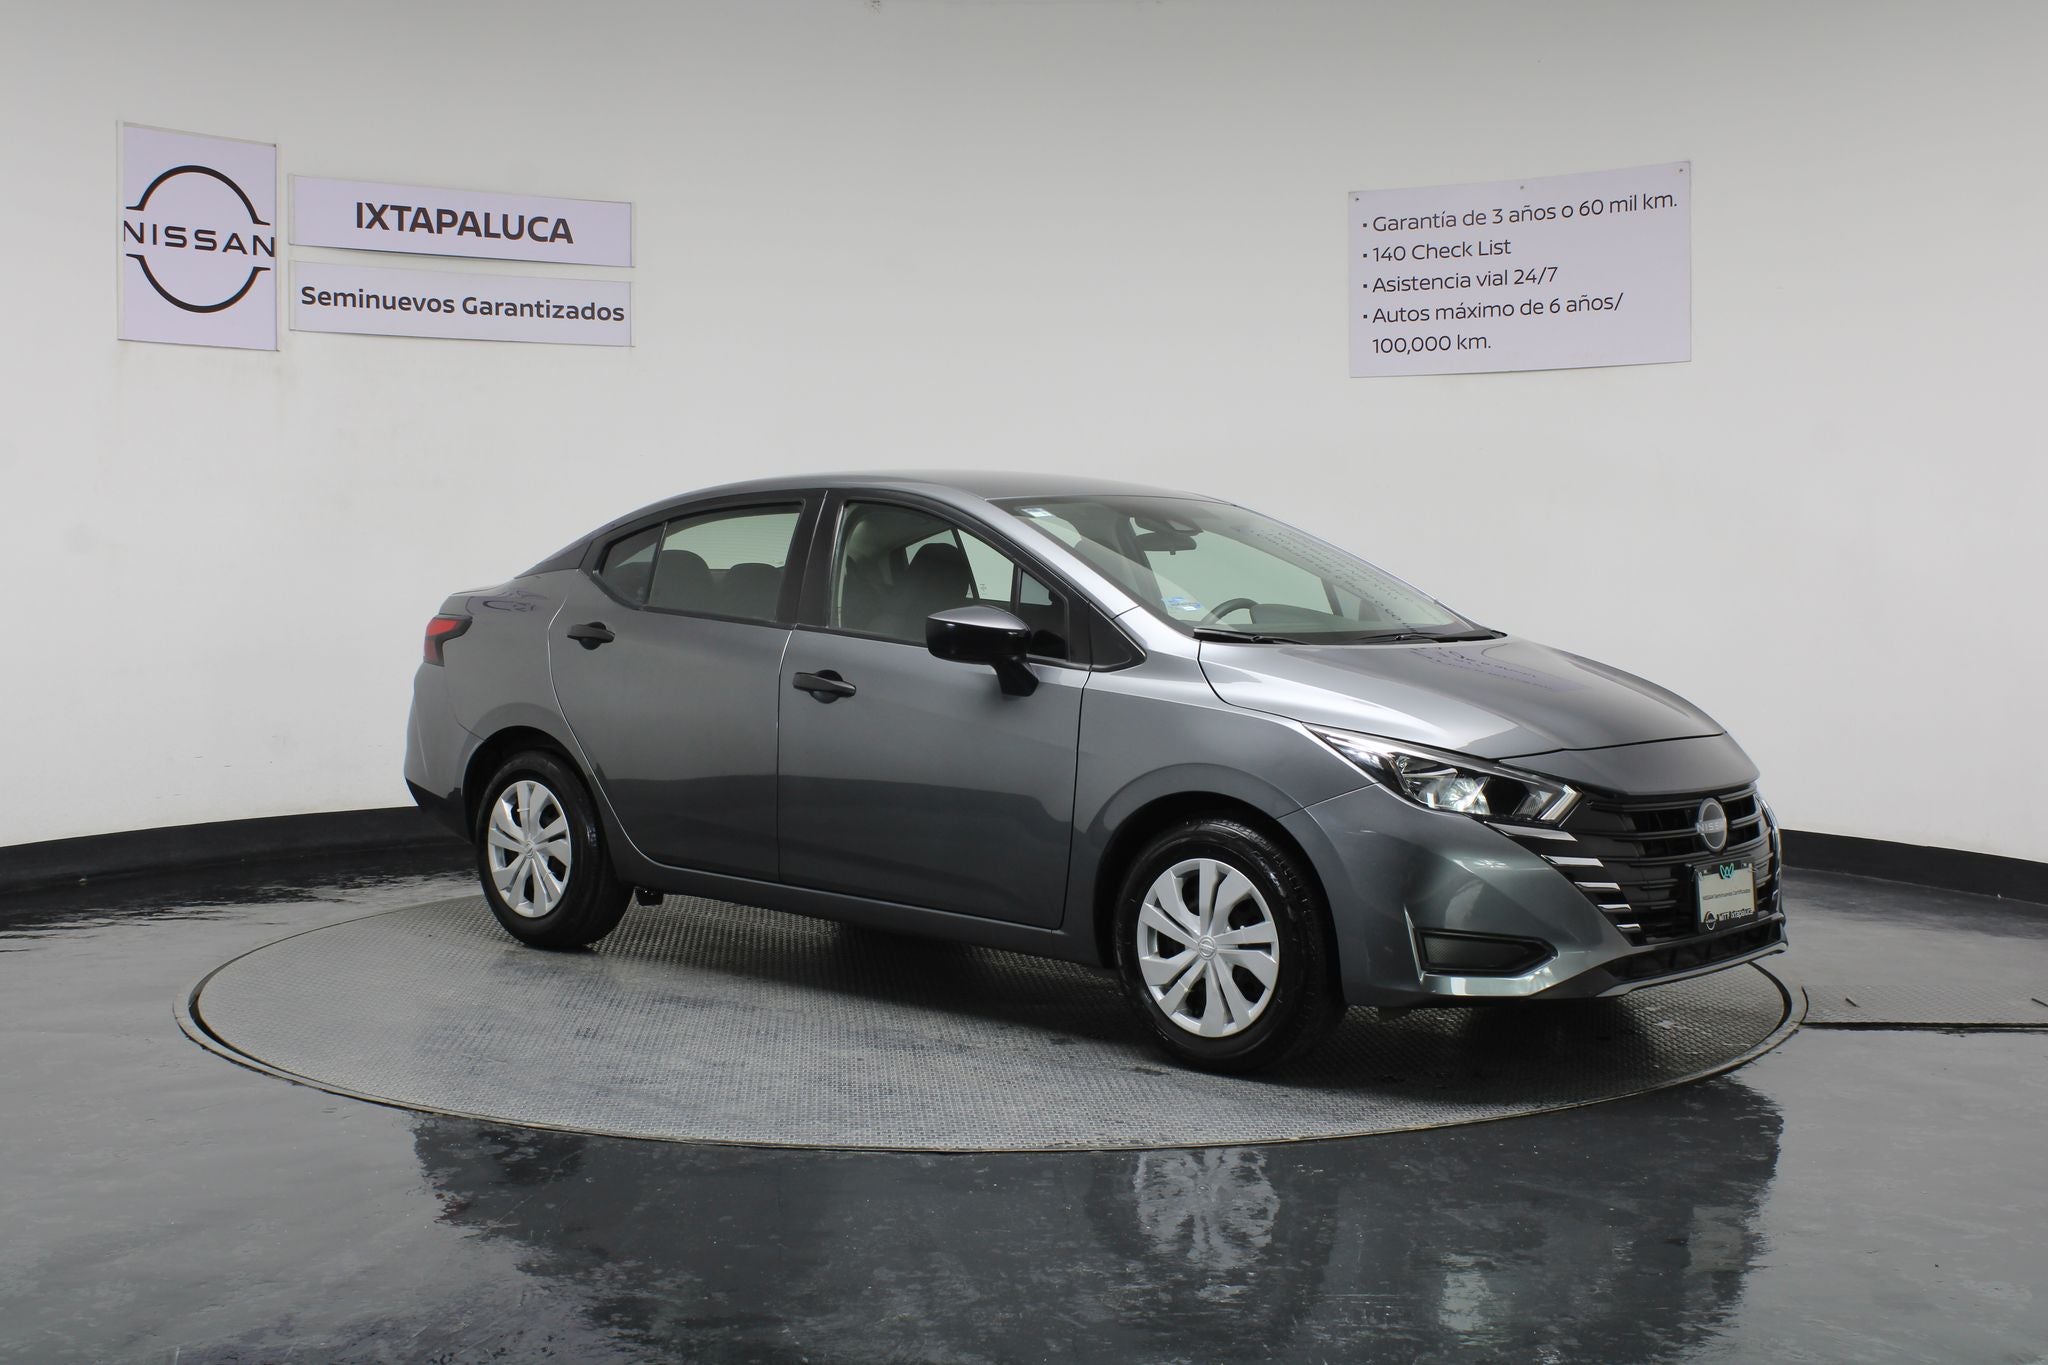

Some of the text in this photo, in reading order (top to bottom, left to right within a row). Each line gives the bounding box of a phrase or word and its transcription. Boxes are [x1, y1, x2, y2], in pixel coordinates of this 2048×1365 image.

[355, 201, 574, 245] IXTAPALUCA
[1372, 192, 1678, 232] Garantía de 3 años o 60 mil km.
[123, 219, 276, 259] NISSAN
[1372, 239, 1512, 263] 140 Check List
[1372, 266, 1559, 294] Asistencia vial 24/7
[301, 285, 625, 322] Seminuevos Garantizados
[1371, 291, 1624, 324] Autos máximo de 6 años/
[1371, 333, 1492, 356] 100,000 km.
